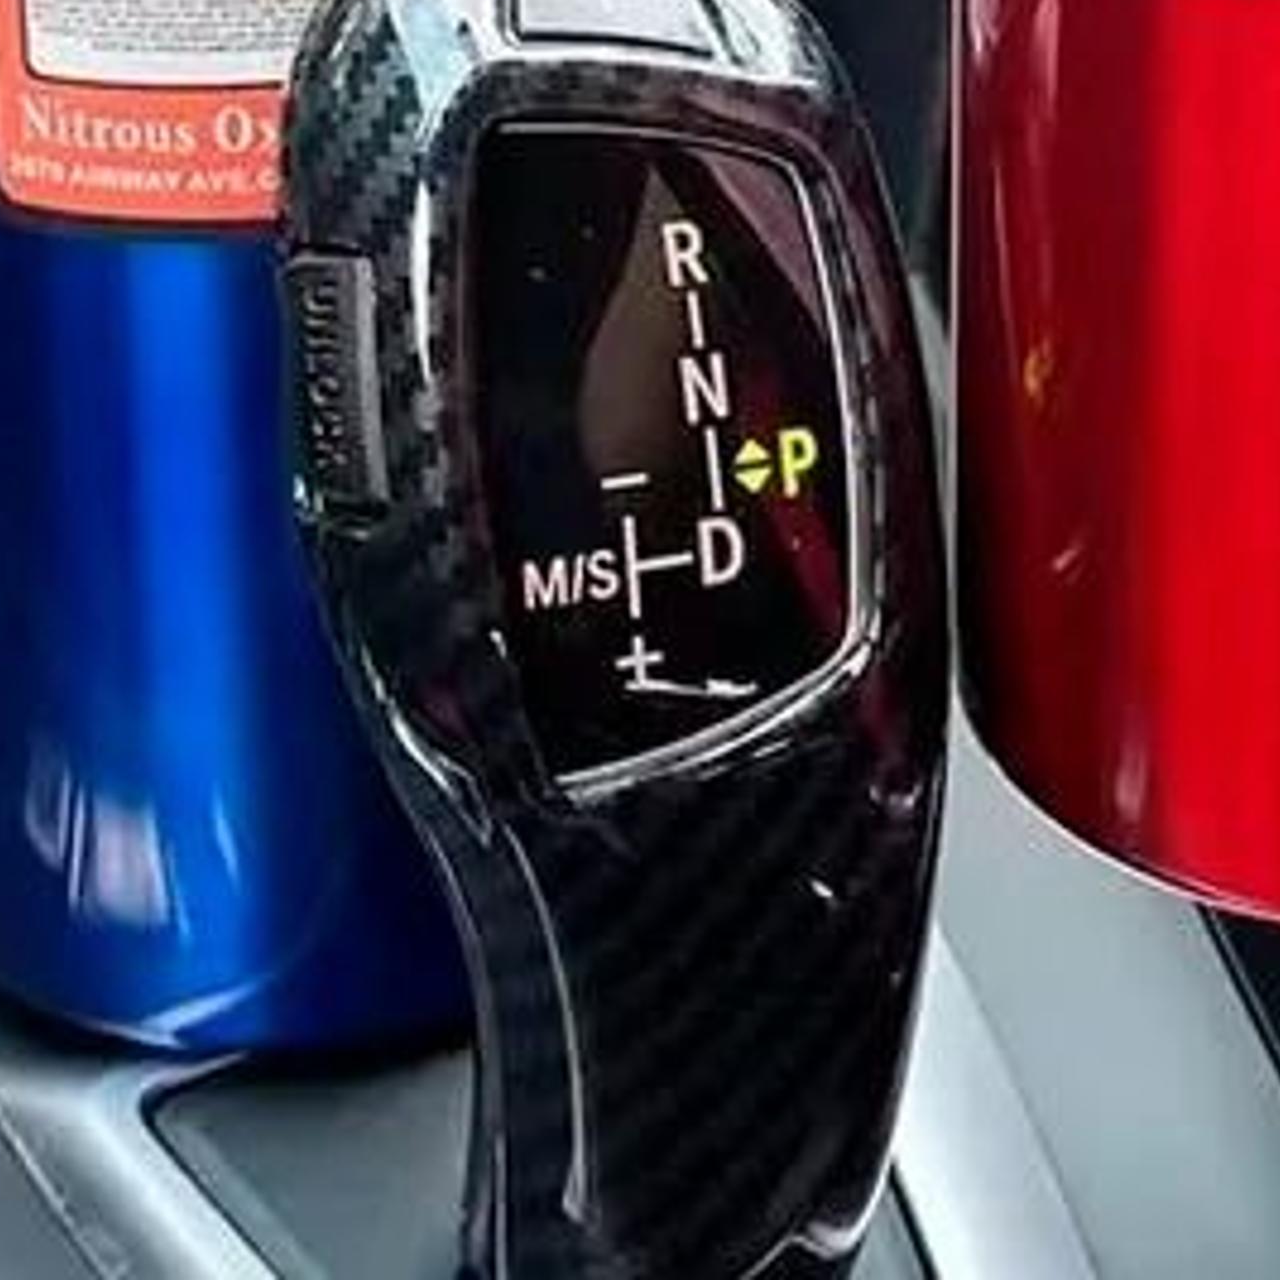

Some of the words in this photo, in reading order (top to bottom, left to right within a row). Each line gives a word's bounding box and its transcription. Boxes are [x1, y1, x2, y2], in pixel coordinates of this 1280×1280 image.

[22, 93, 201, 155] Nitrous
[661, 220, 710, 289] R
[677, 351, 732, 426] N
[777, 427, 819, 500] P
[521, 547, 622, 612] M/S
[697, 516, 745, 589] D
